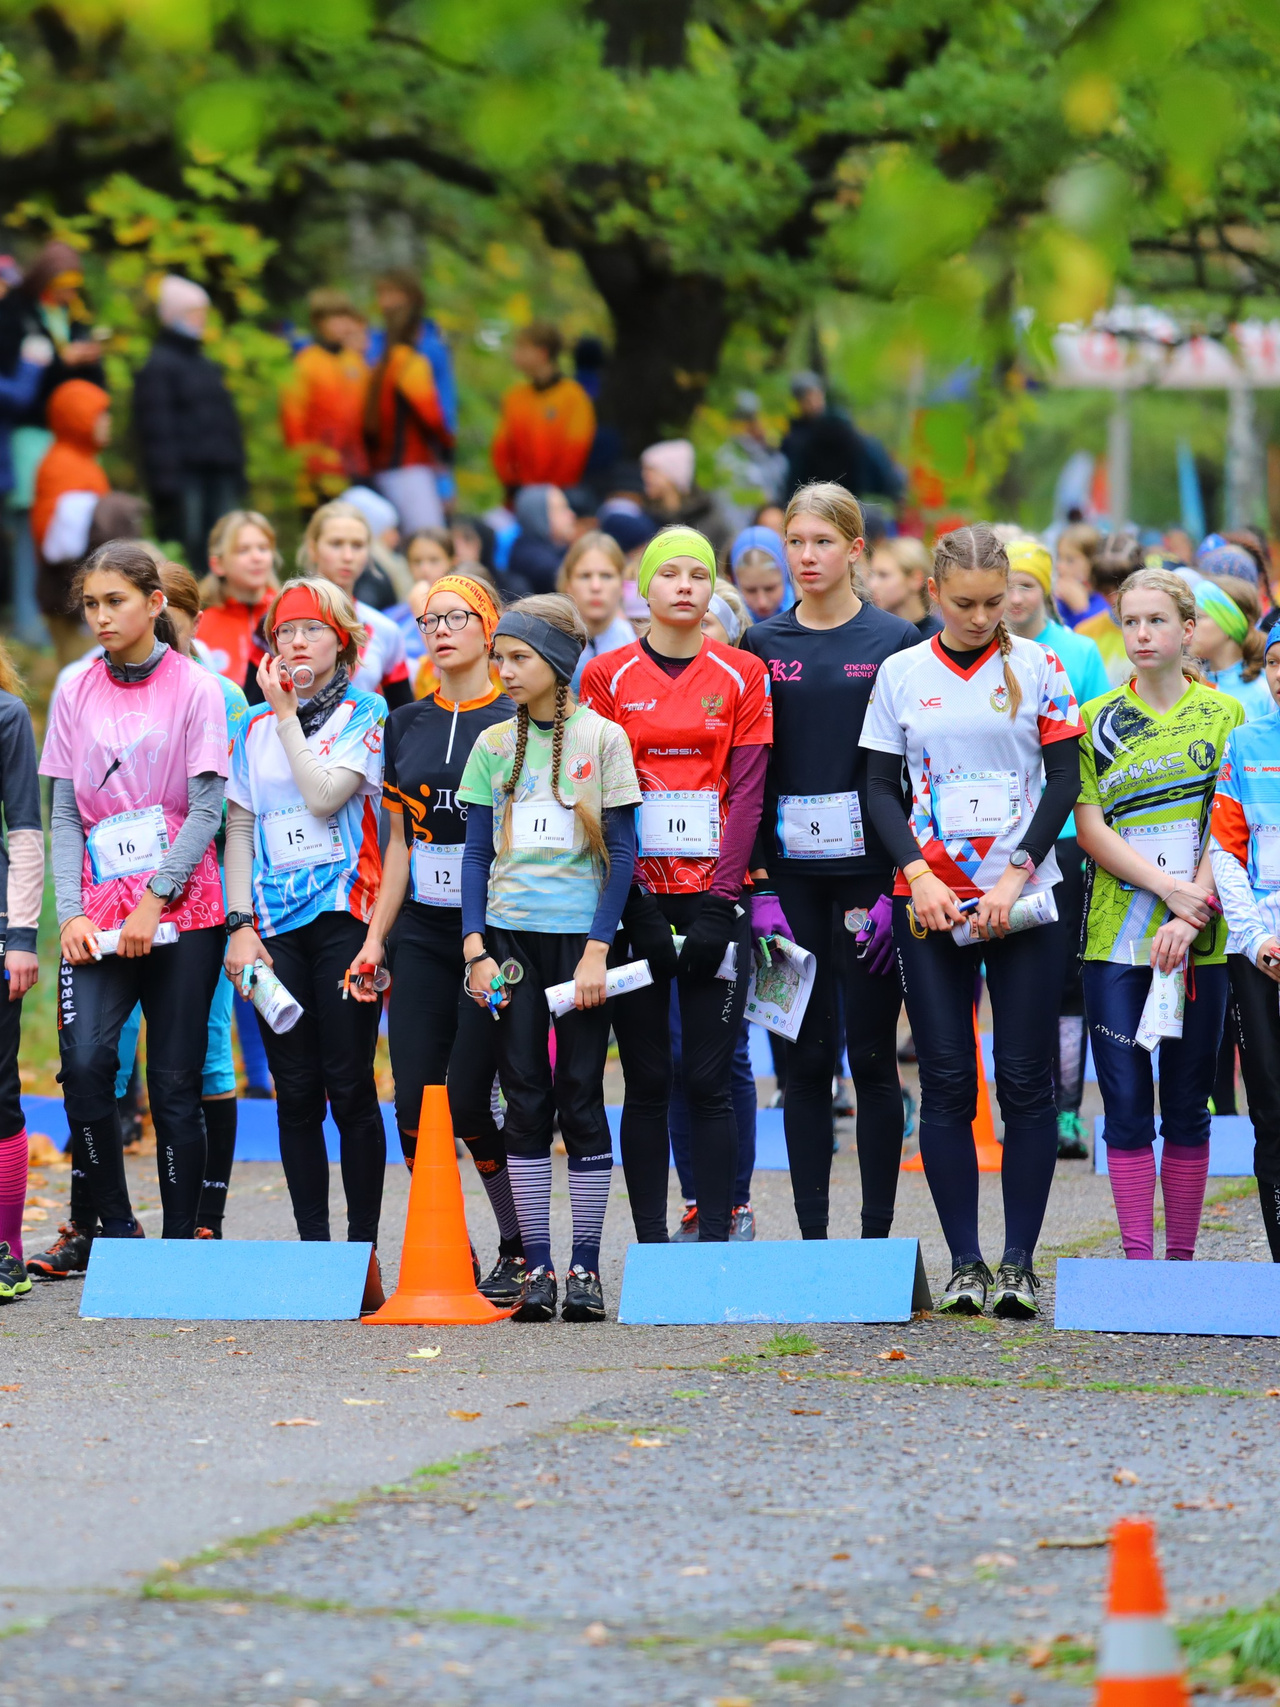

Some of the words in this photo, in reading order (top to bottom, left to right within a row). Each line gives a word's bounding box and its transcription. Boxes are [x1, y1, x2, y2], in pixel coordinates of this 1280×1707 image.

[647, 748, 703, 756] RUSSIA
[969, 798, 979, 814] 7
[533, 818, 547, 832] 11
[667, 818, 686, 833] 10
[810, 821, 820, 836] 8
[287, 828, 305, 846] 15
[117, 839, 135, 856] 16
[1157, 852, 1166, 867] 6
[434, 870, 451, 884] 12
